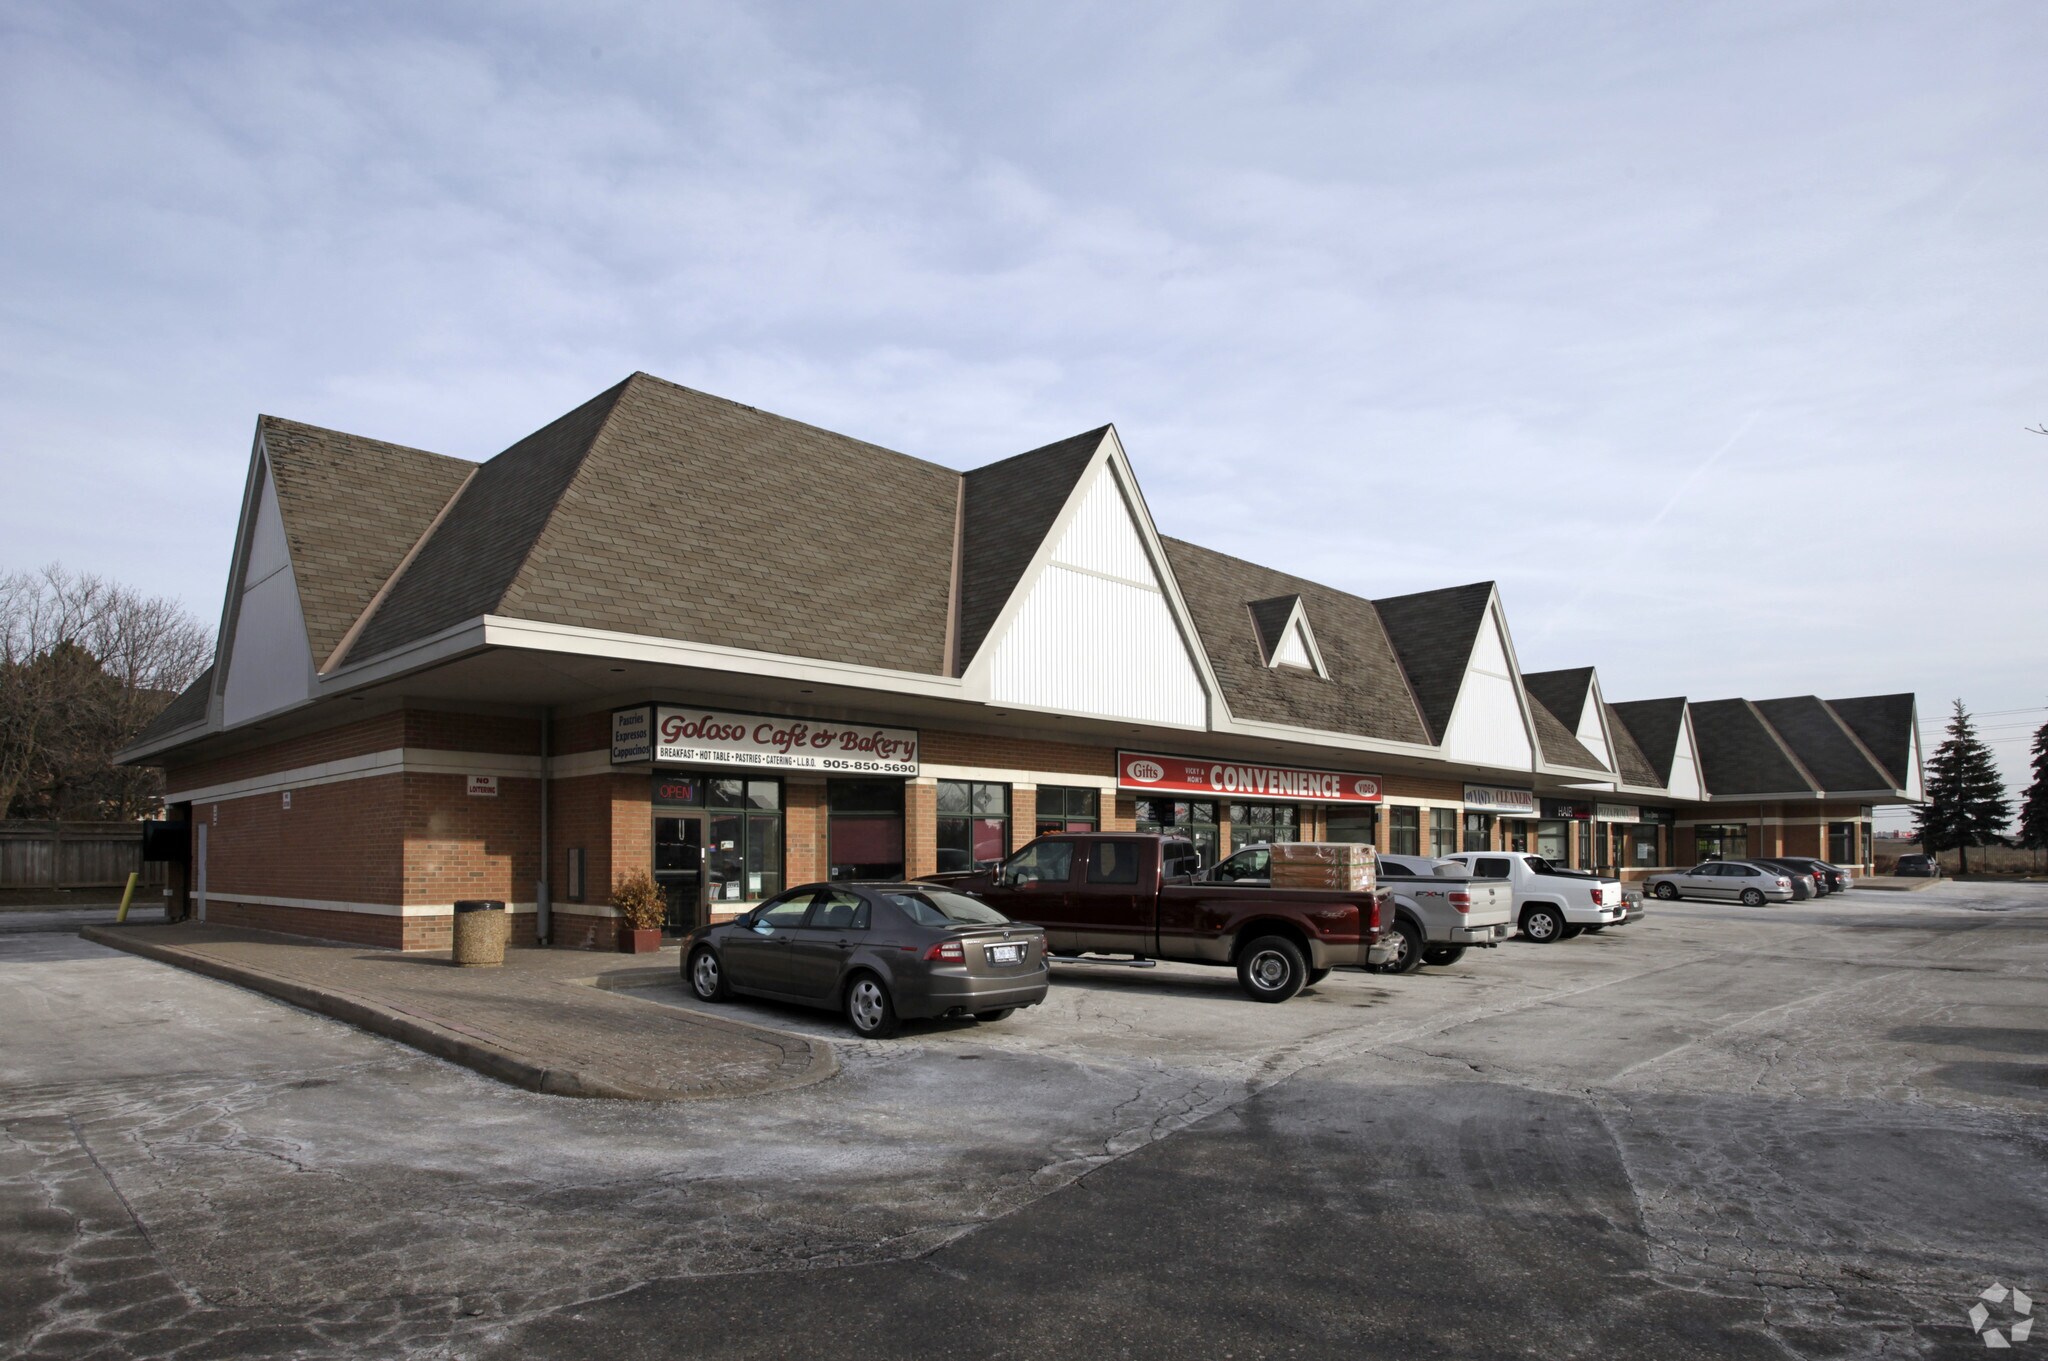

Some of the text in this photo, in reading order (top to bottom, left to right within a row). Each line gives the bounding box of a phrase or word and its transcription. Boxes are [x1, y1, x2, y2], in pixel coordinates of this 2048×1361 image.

[619, 713, 644, 727] Pastries
[615, 729, 647, 742] Expressos
[661, 715, 916, 763] Goloso Café & Bakery
[613, 744, 650, 759] Cappucinos
[660, 747, 694, 759] BREAKFAST
[700, 750, 711, 760] HOT
[713, 751, 730, 762] TABLE
[735, 752, 762, 764] PASTRIES
[766, 754, 792, 766] CATERING
[823, 759, 916, 773] 905-850-5690
[1133, 763, 1159, 779] Gifts
[1210, 765, 1340, 798] CONVENIENCE
[1359, 783, 1375, 794] VIDEO
[660, 784, 691, 799] OPEN
[1495, 789, 1532, 805] CLEANERS
[1558, 806, 1573, 817] HAIR
[1415, 890, 1445, 898] FX4
